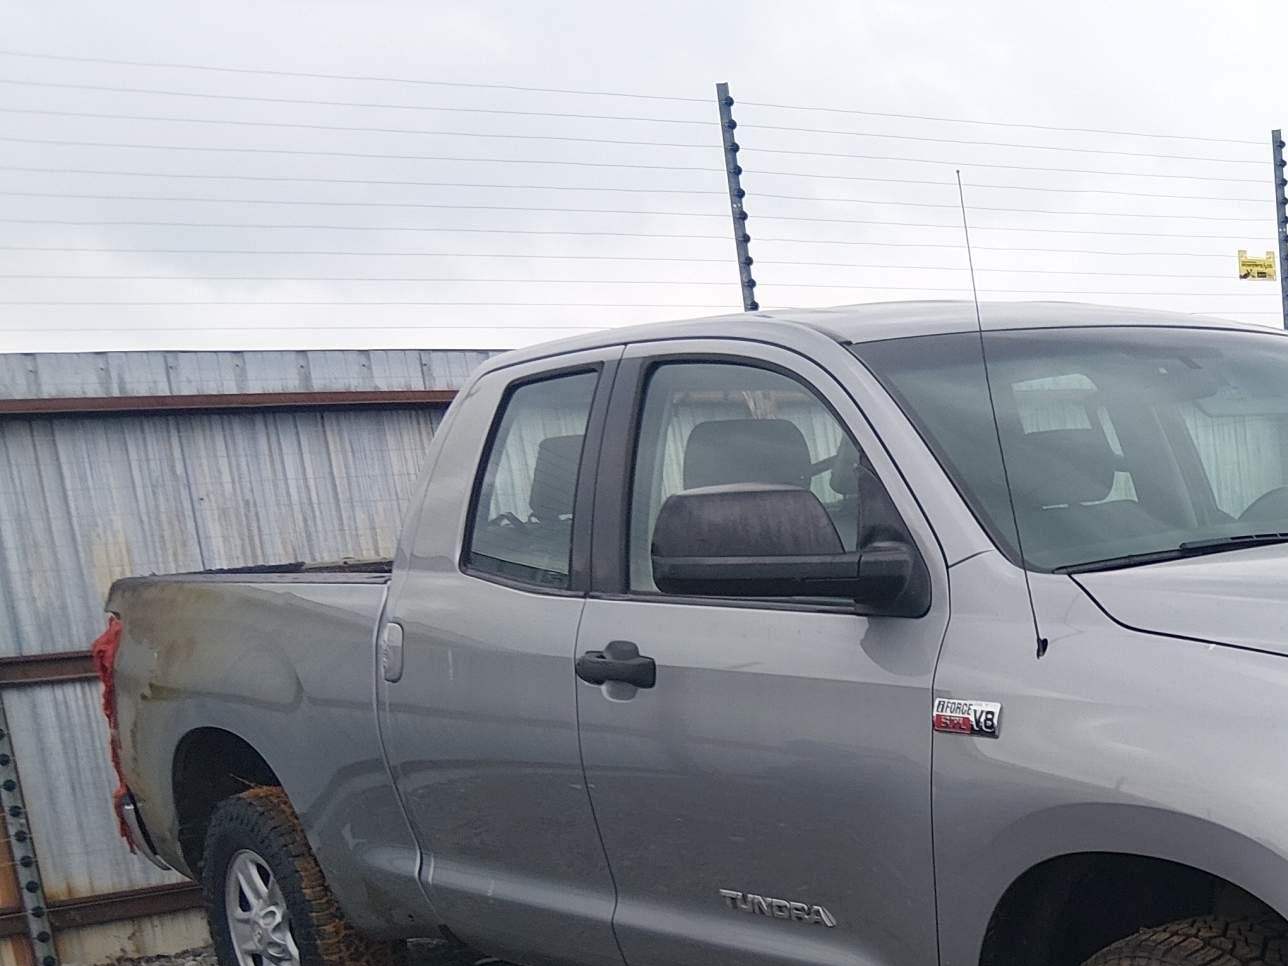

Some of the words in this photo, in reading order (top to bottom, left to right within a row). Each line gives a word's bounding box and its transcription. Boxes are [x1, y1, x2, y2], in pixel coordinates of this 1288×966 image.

[945, 701, 973, 716] FORCE
[973, 708, 996, 732] V8
[719, 887, 837, 928] TUNDRA
